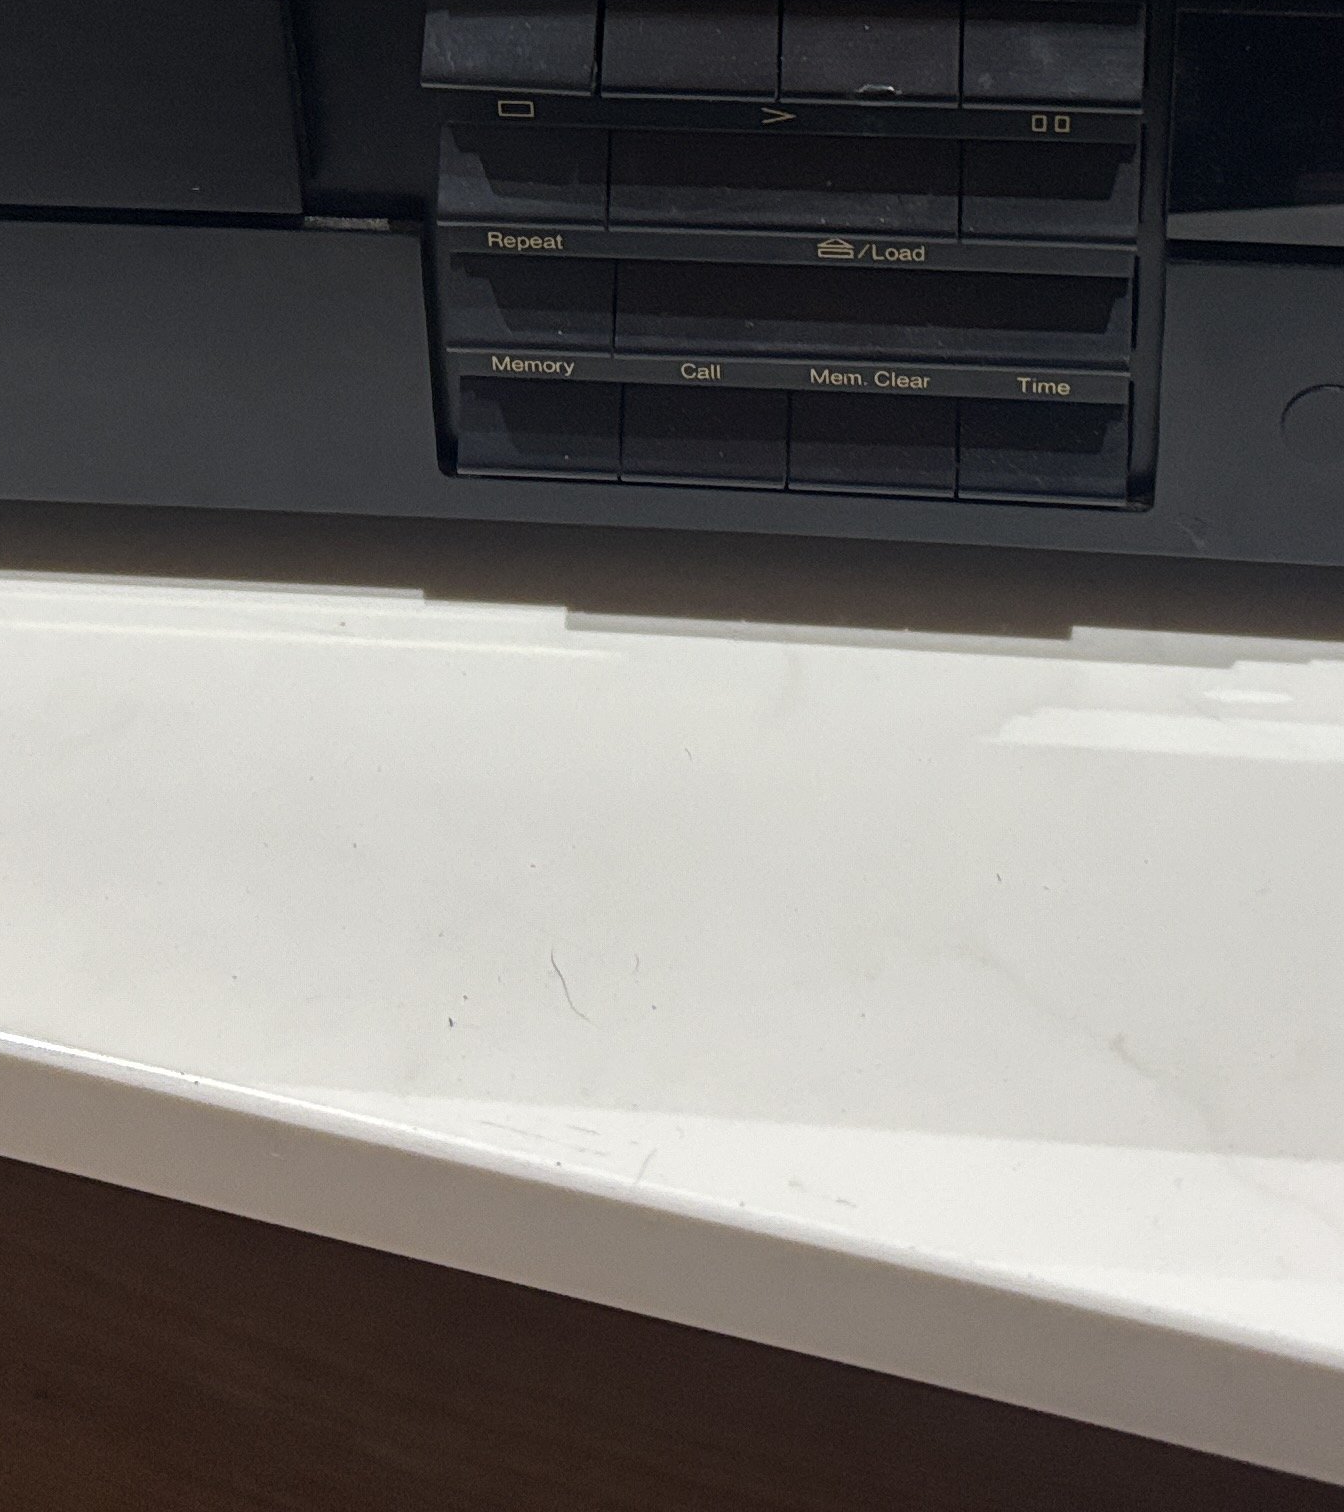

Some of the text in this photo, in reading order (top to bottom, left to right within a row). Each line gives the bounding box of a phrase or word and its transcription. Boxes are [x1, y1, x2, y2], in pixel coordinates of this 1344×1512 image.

[487, 231, 564, 251] Repeat
[491, 355, 575, 377] Memory
[680, 363, 722, 380] Call
[809, 368, 931, 389] Mem. Clear
[1016, 376, 1071, 396] Time
